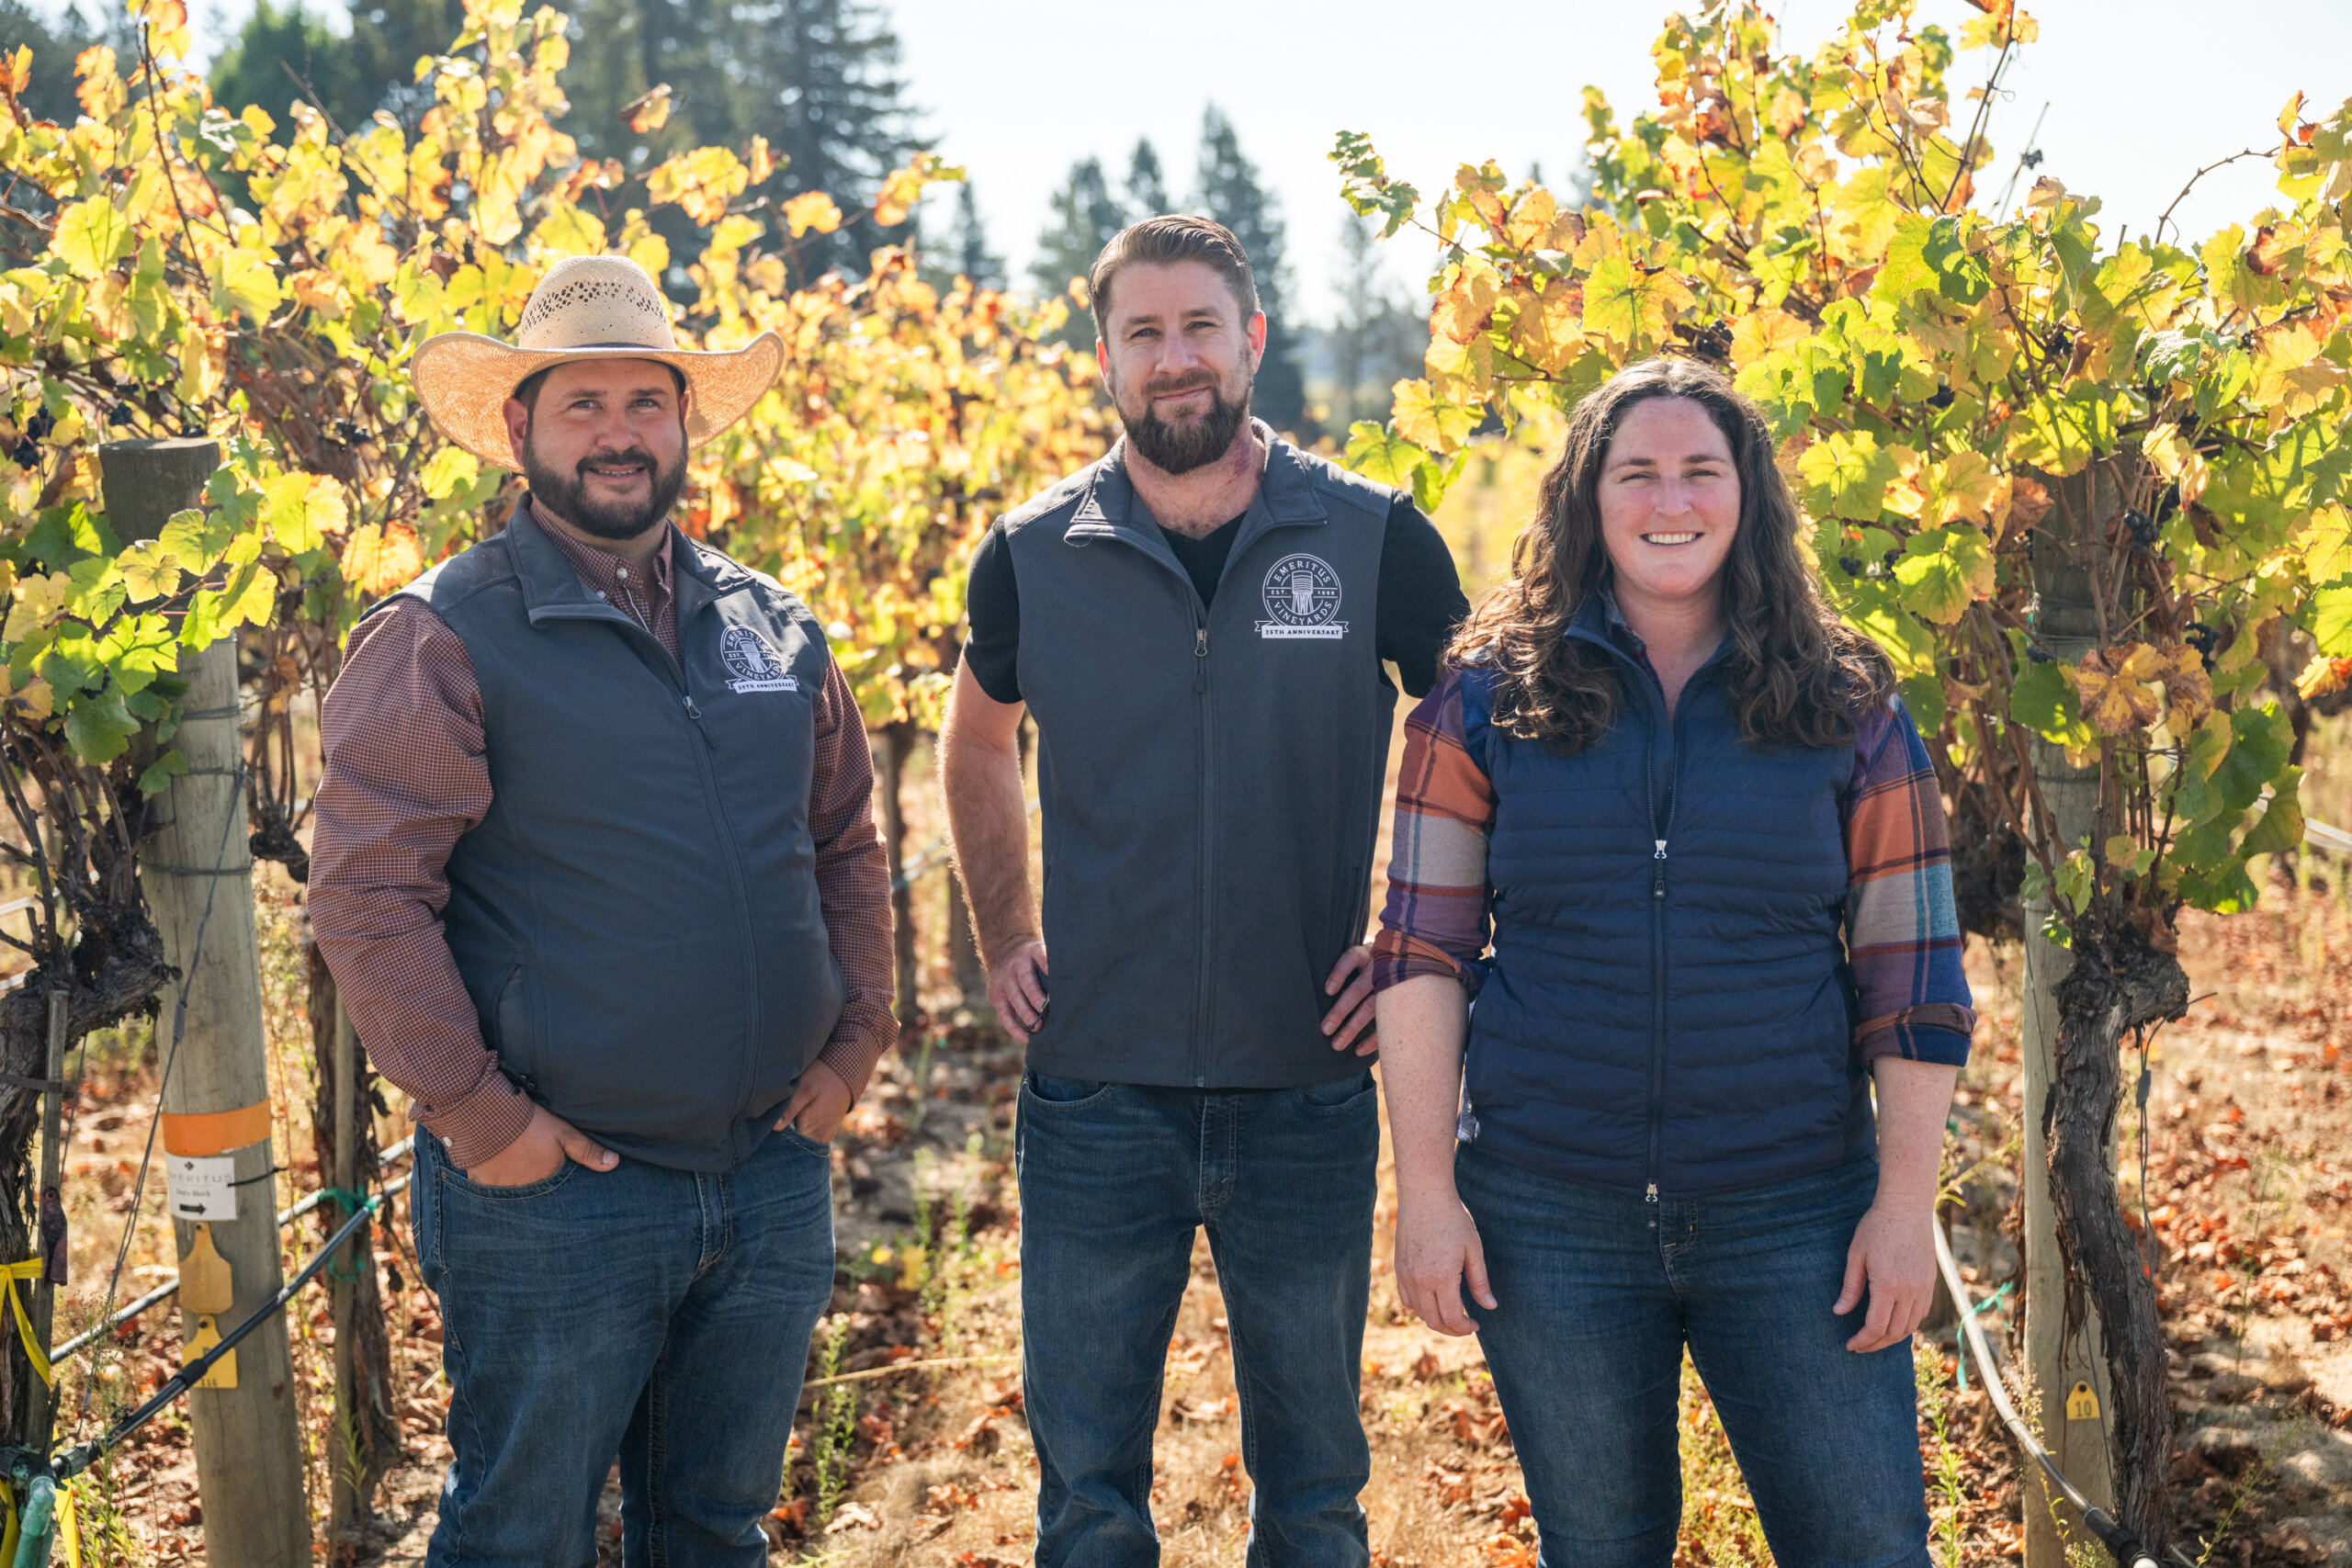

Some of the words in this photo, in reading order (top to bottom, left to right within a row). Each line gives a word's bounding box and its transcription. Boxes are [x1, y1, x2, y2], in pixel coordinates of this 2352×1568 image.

[1273, 560, 1331, 583] EMERITUS
[1273, 601, 1332, 626] VINEYARDS
[736, 661, 782, 681] VINEYARDS
[2075, 1400, 2092, 1417] 10
